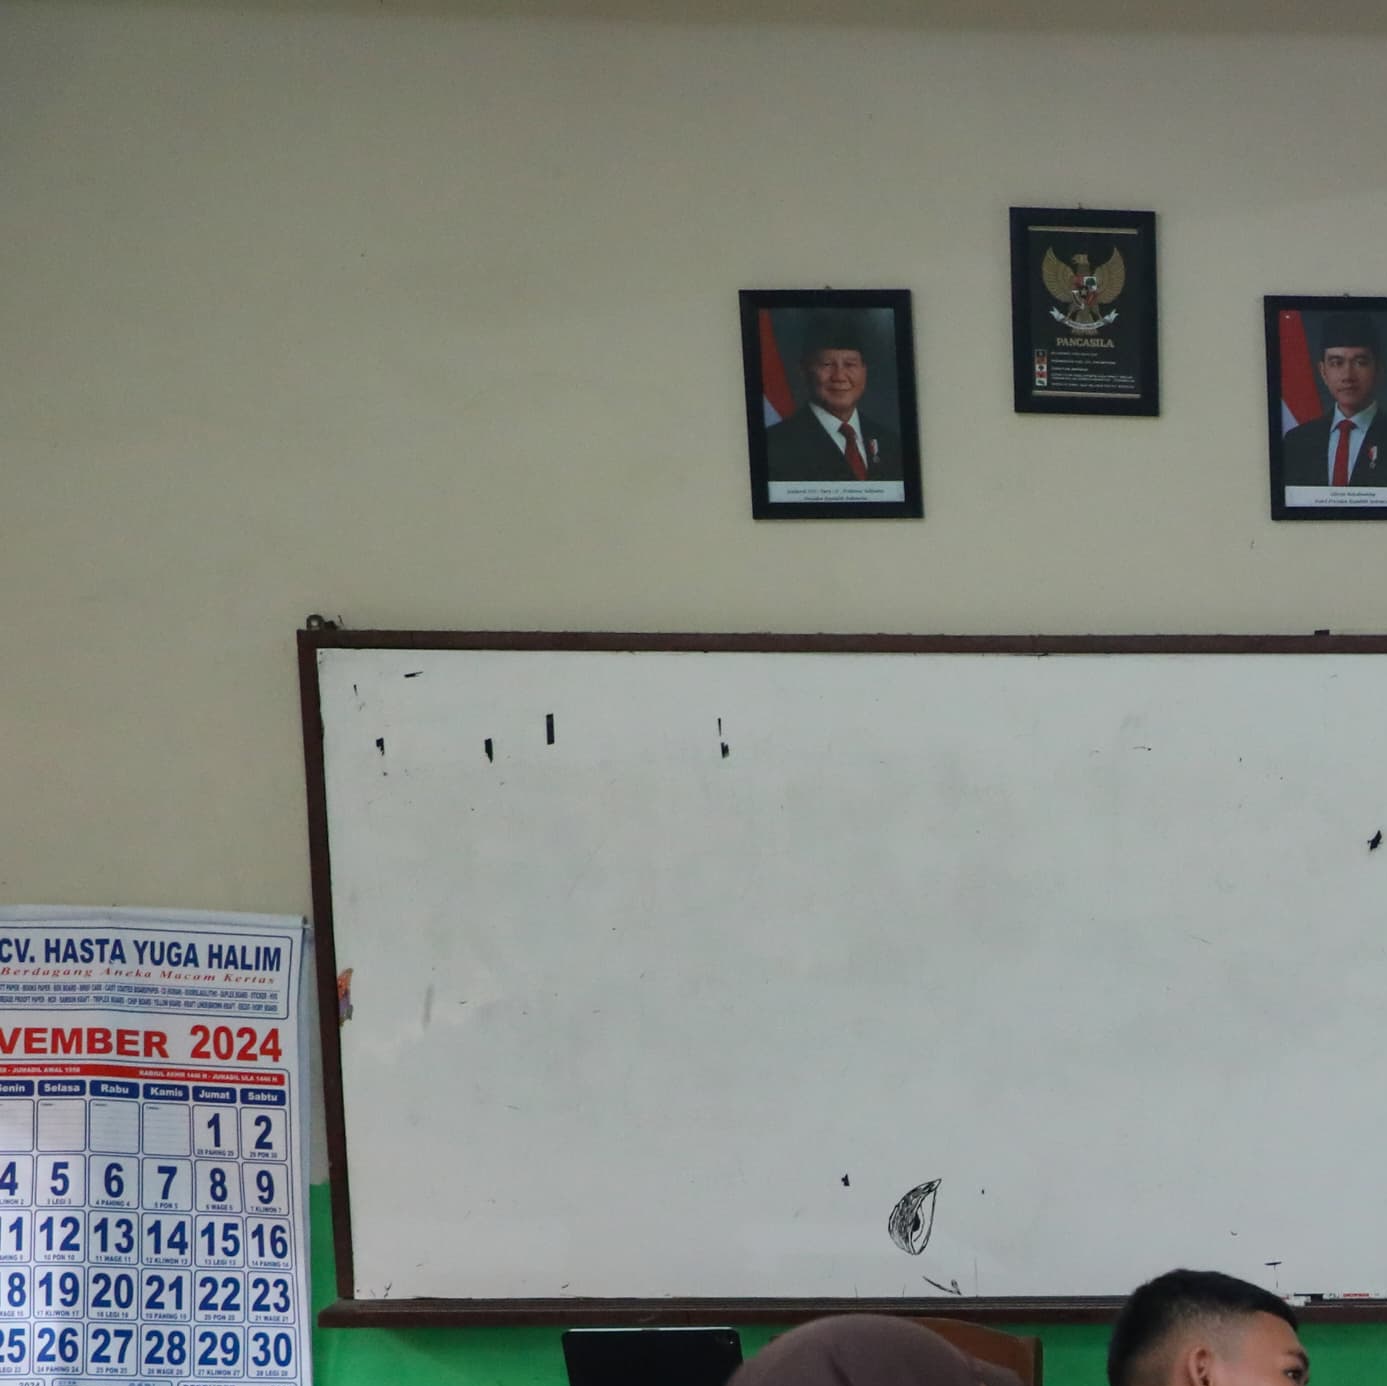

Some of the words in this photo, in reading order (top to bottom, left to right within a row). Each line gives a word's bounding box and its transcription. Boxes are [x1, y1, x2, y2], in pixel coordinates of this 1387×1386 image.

[1056, 337, 1115, 348] PANCASILA
[0, 938, 35, 964] CV.
[44, 938, 127, 965] HASTA
[132, 940, 200, 968] YUGA
[207, 944, 282, 972] HALIM
[1, 966, 94, 978] Berdagang
[100, 967, 152, 978] Aneka
[160, 970, 216, 982] Macam
[223, 973, 275, 985] Kertas
[190, 1024, 282, 1062] 2024
[44, 1083, 80, 1092] Selasa
[101, 1084, 129, 1094] Rabu
[150, 1087, 184, 1098] Kamis
[199, 1089, 231, 1100] Jumat
[248, 1092, 278, 1102] Sabtu
[208, 1112, 220, 1148] 1
[254, 1115, 272, 1150] 2
[0, 1162, 18, 1196] 4
[50, 1162, 70, 1196] 5
[104, 1162, 124, 1198] 6
[157, 1166, 178, 1200] 7
[210, 1168, 228, 1202] 8
[256, 1170, 274, 1204] 9
[0, 1216, 23, 1252] 1
[40, 1216, 80, 1252] 12
[94, 1217, 134, 1254] 13
[147, 1220, 188, 1256] 14
[201, 1222, 240, 1257] 15
[252, 1224, 288, 1259] 16
[38, 1272, 80, 1308] 19
[91, 1272, 134, 1308] 20
[145, 1274, 184, 1310] 21
[198, 1276, 240, 1311] 22
[252, 1278, 290, 1312] 23
[37, 1328, 79, 1362] 26
[90, 1328, 134, 1364] 27
[144, 1330, 186, 1366] 28
[198, 1332, 240, 1366] 29
[252, 1332, 292, 1367] 30
